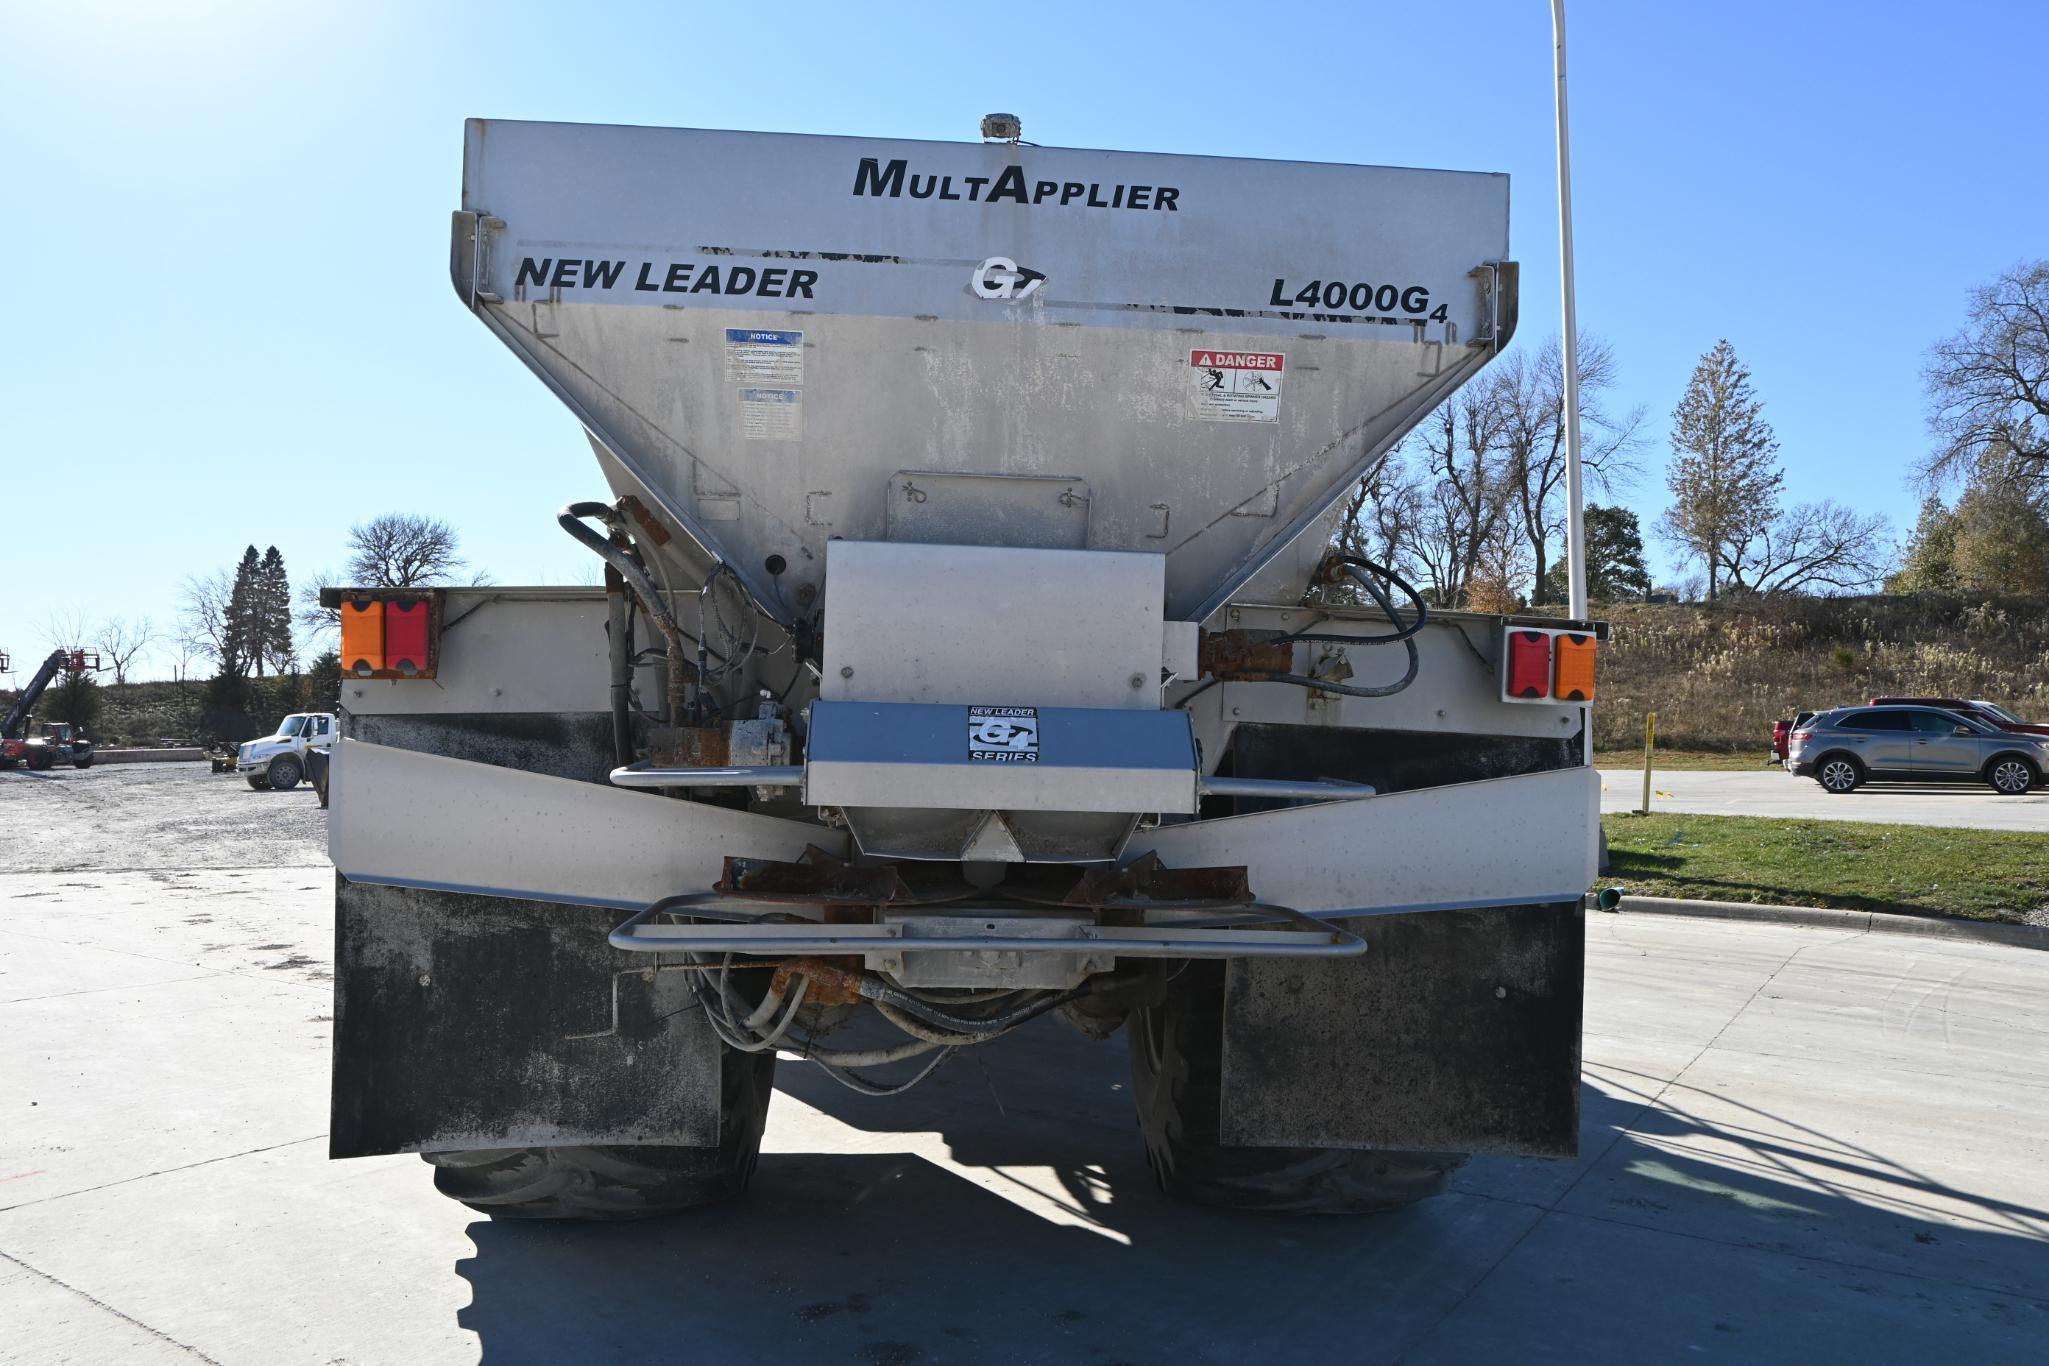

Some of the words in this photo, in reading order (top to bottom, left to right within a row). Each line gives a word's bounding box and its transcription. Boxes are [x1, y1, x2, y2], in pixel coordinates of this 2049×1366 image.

[515, 258, 626, 288] NEW
[634, 262, 819, 300] LEADER
[750, 333, 778, 341] NOTICE
[1215, 354, 1276, 369] DANGER
[756, 392, 784, 400] NOTICE
[970, 707, 993, 716] NEW
[995, 708, 1034, 717] LEADER
[979, 719, 1029, 750] G4
[972, 751, 1037, 762] SERIES
